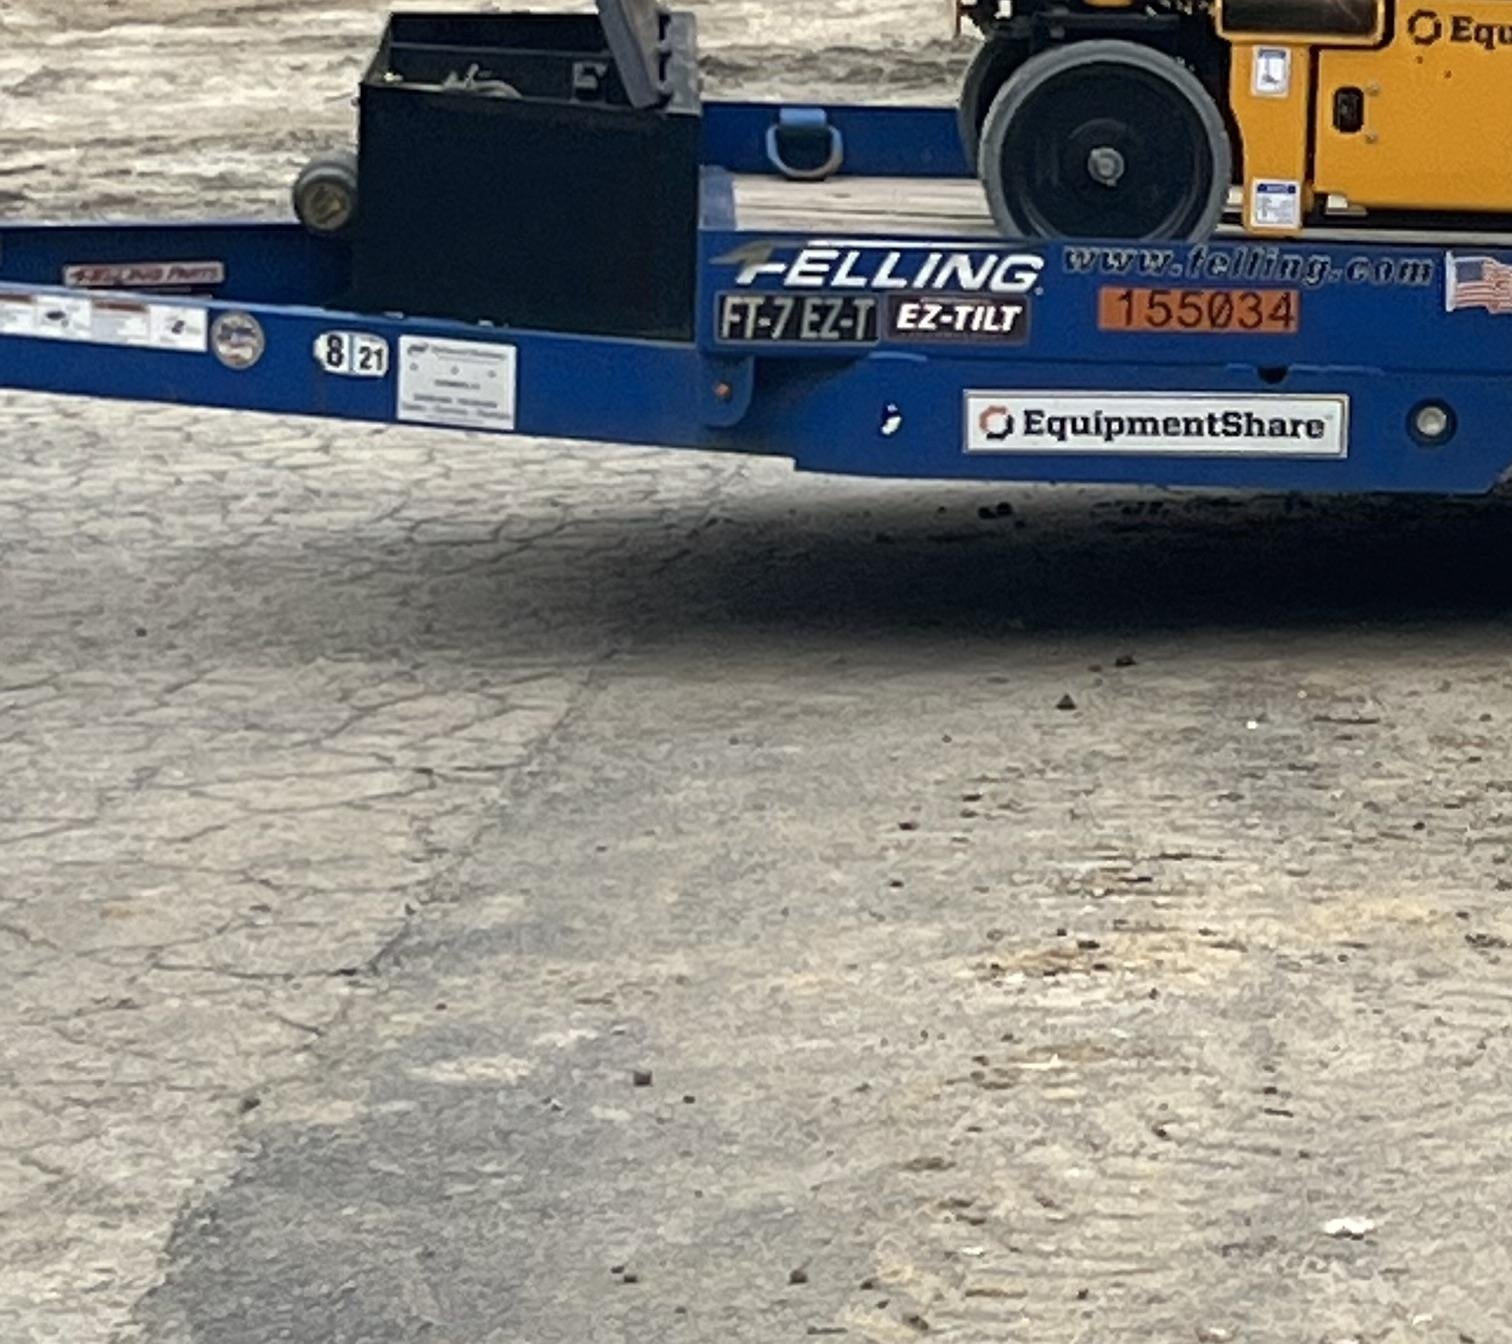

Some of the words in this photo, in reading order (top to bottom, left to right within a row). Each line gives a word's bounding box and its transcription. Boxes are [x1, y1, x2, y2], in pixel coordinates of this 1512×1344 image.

[709, 242, 1045, 293] FELLING
[1062, 246, 1434, 287] www.felling.com
[722, 296, 795, 340] FT-7
[801, 298, 876, 340] EZ-T
[896, 304, 1024, 333] EZ-TILT
[1115, 289, 1296, 330] 155034
[326, 334, 345, 368] 8
[358, 346, 384, 371] 21
[1022, 409, 1326, 442] EquipmentShare
